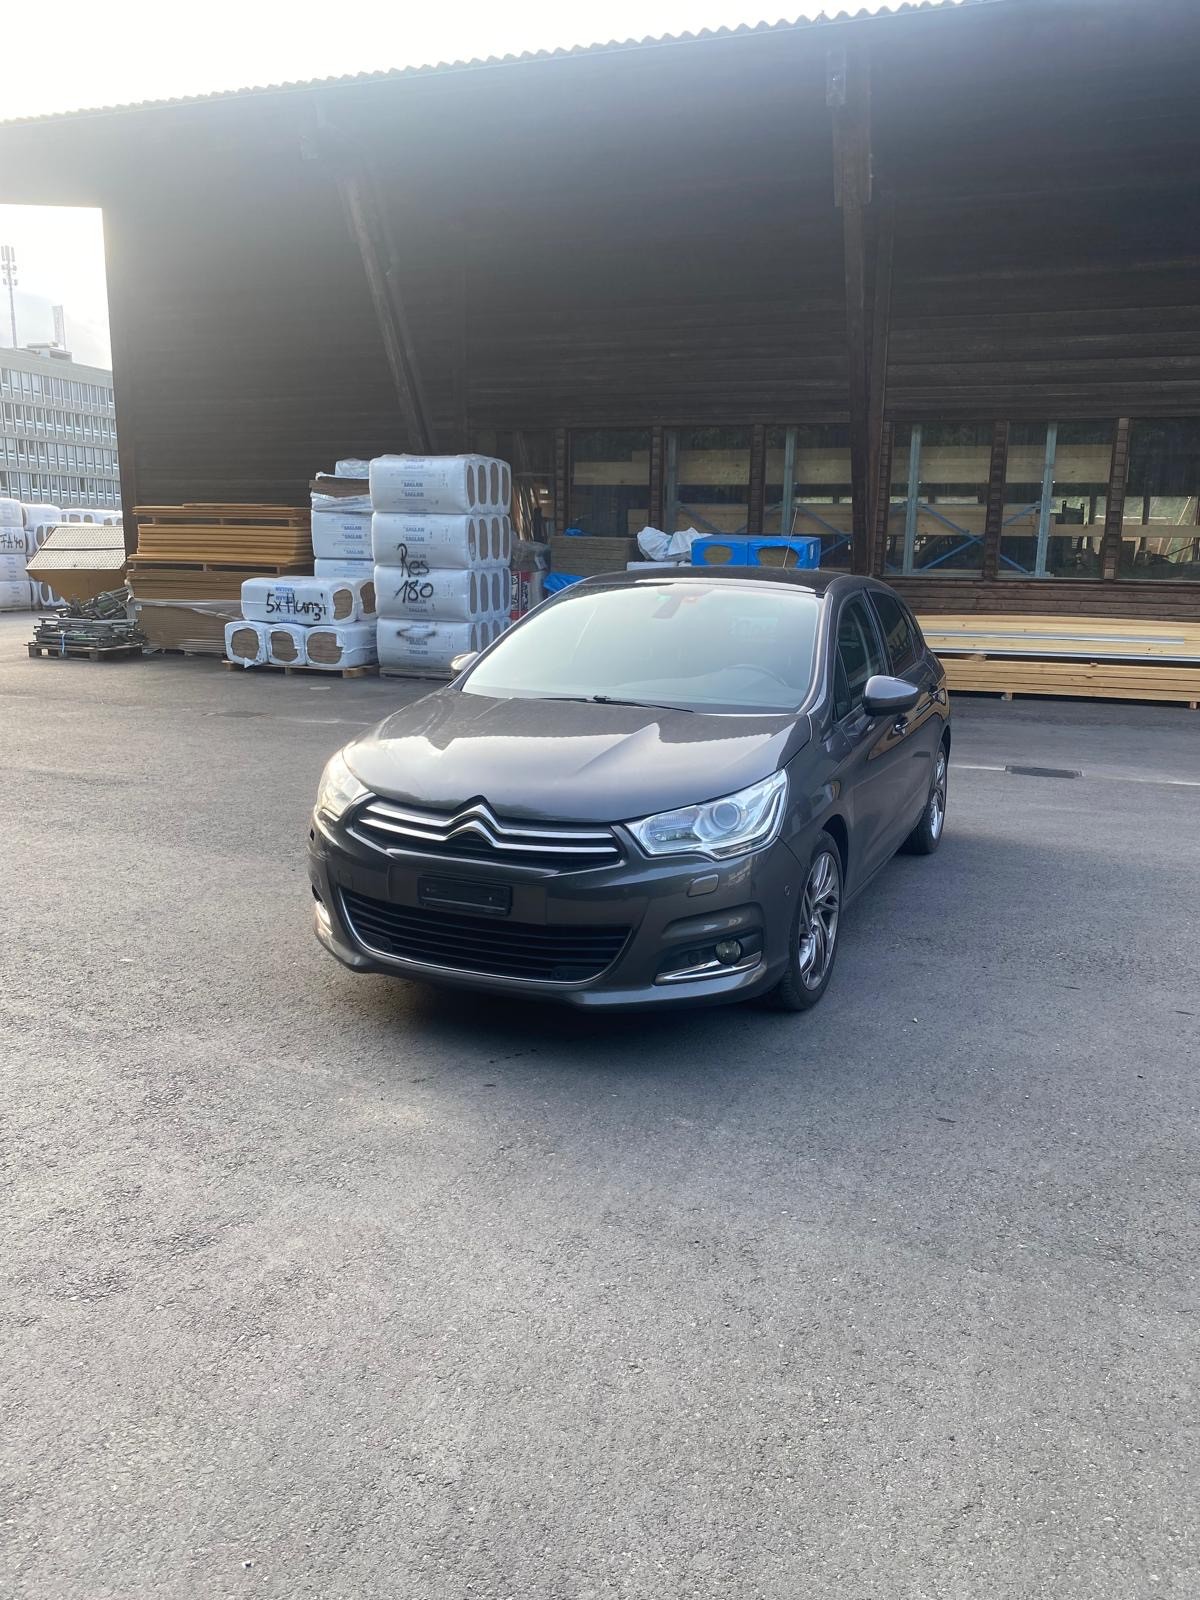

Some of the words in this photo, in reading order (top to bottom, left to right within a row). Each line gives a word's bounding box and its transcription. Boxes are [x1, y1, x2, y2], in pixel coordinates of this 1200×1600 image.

[396, 543, 430, 577] Res
[266, 592, 282, 613] 5x
[393, 578, 434, 603] 180
